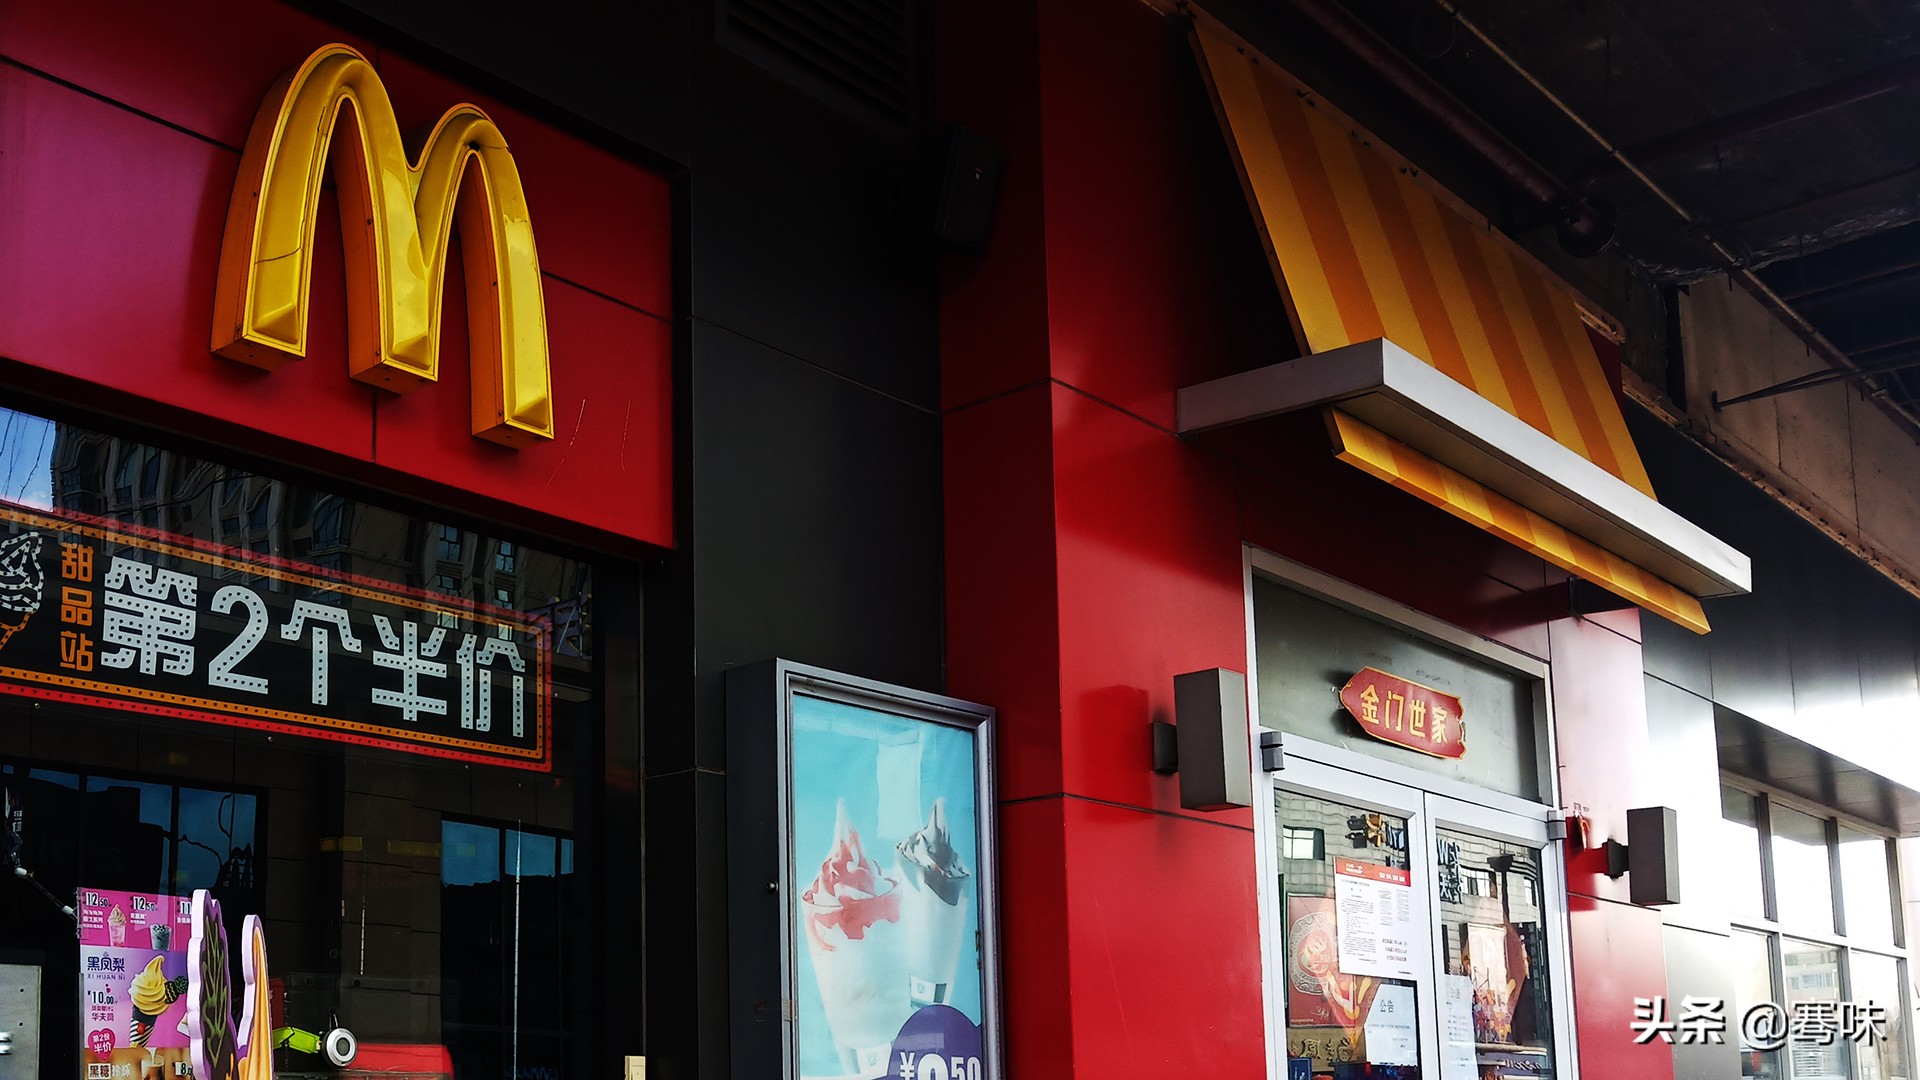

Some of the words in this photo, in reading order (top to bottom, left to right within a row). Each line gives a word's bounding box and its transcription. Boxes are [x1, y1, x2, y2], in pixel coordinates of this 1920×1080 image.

[60, 543, 93, 672] 甜品站
[101, 556, 525, 737] 第2个半价
[1360, 684, 1448, 744] 金门世家
[87, 955, 125, 973] 黑凤梨
[93, 1042, 112, 1053] 半价
